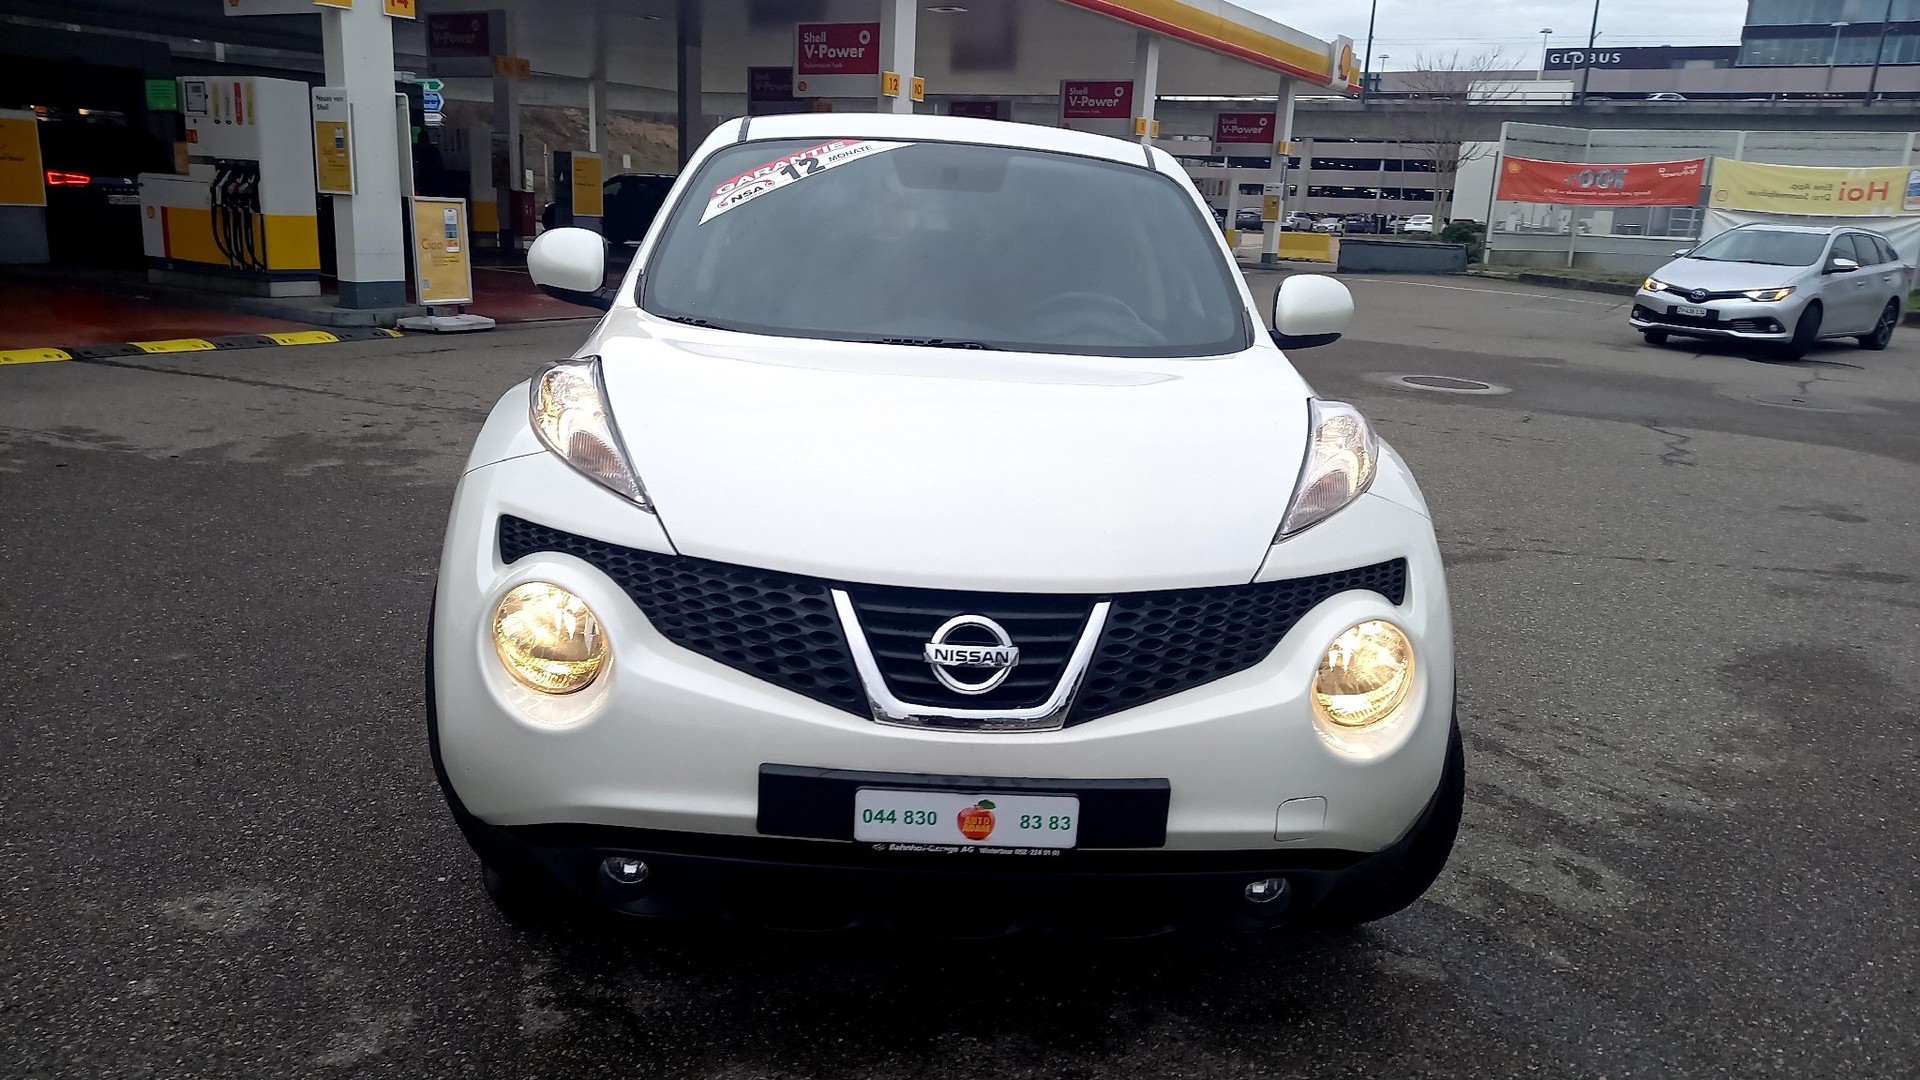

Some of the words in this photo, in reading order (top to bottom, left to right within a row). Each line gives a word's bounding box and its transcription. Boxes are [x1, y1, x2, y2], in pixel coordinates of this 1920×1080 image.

[803, 31, 827, 43] Shell
[804, 44, 865, 58] V-Power
[1550, 52, 1622, 64] GLOBUS
[889, 78, 898, 91] 12
[914, 84, 922, 95] 10
[1069, 87, 1088, 95] Shell
[1069, 96, 1119, 107] V-Power
[1221, 125, 1263, 134] V-Power
[715, 140, 846, 195] GARANTIE
[780, 157, 826, 180] 12
[828, 144, 874, 162] MONATE
[731, 186, 764, 203] NSA
[934, 648, 1010, 664] NISSAN
[862, 808, 897, 824] 044
[903, 810, 938, 826] 830
[965, 816, 990, 825] AUTO
[1020, 814, 1042, 830] 83
[1049, 815, 1071, 831] 83
